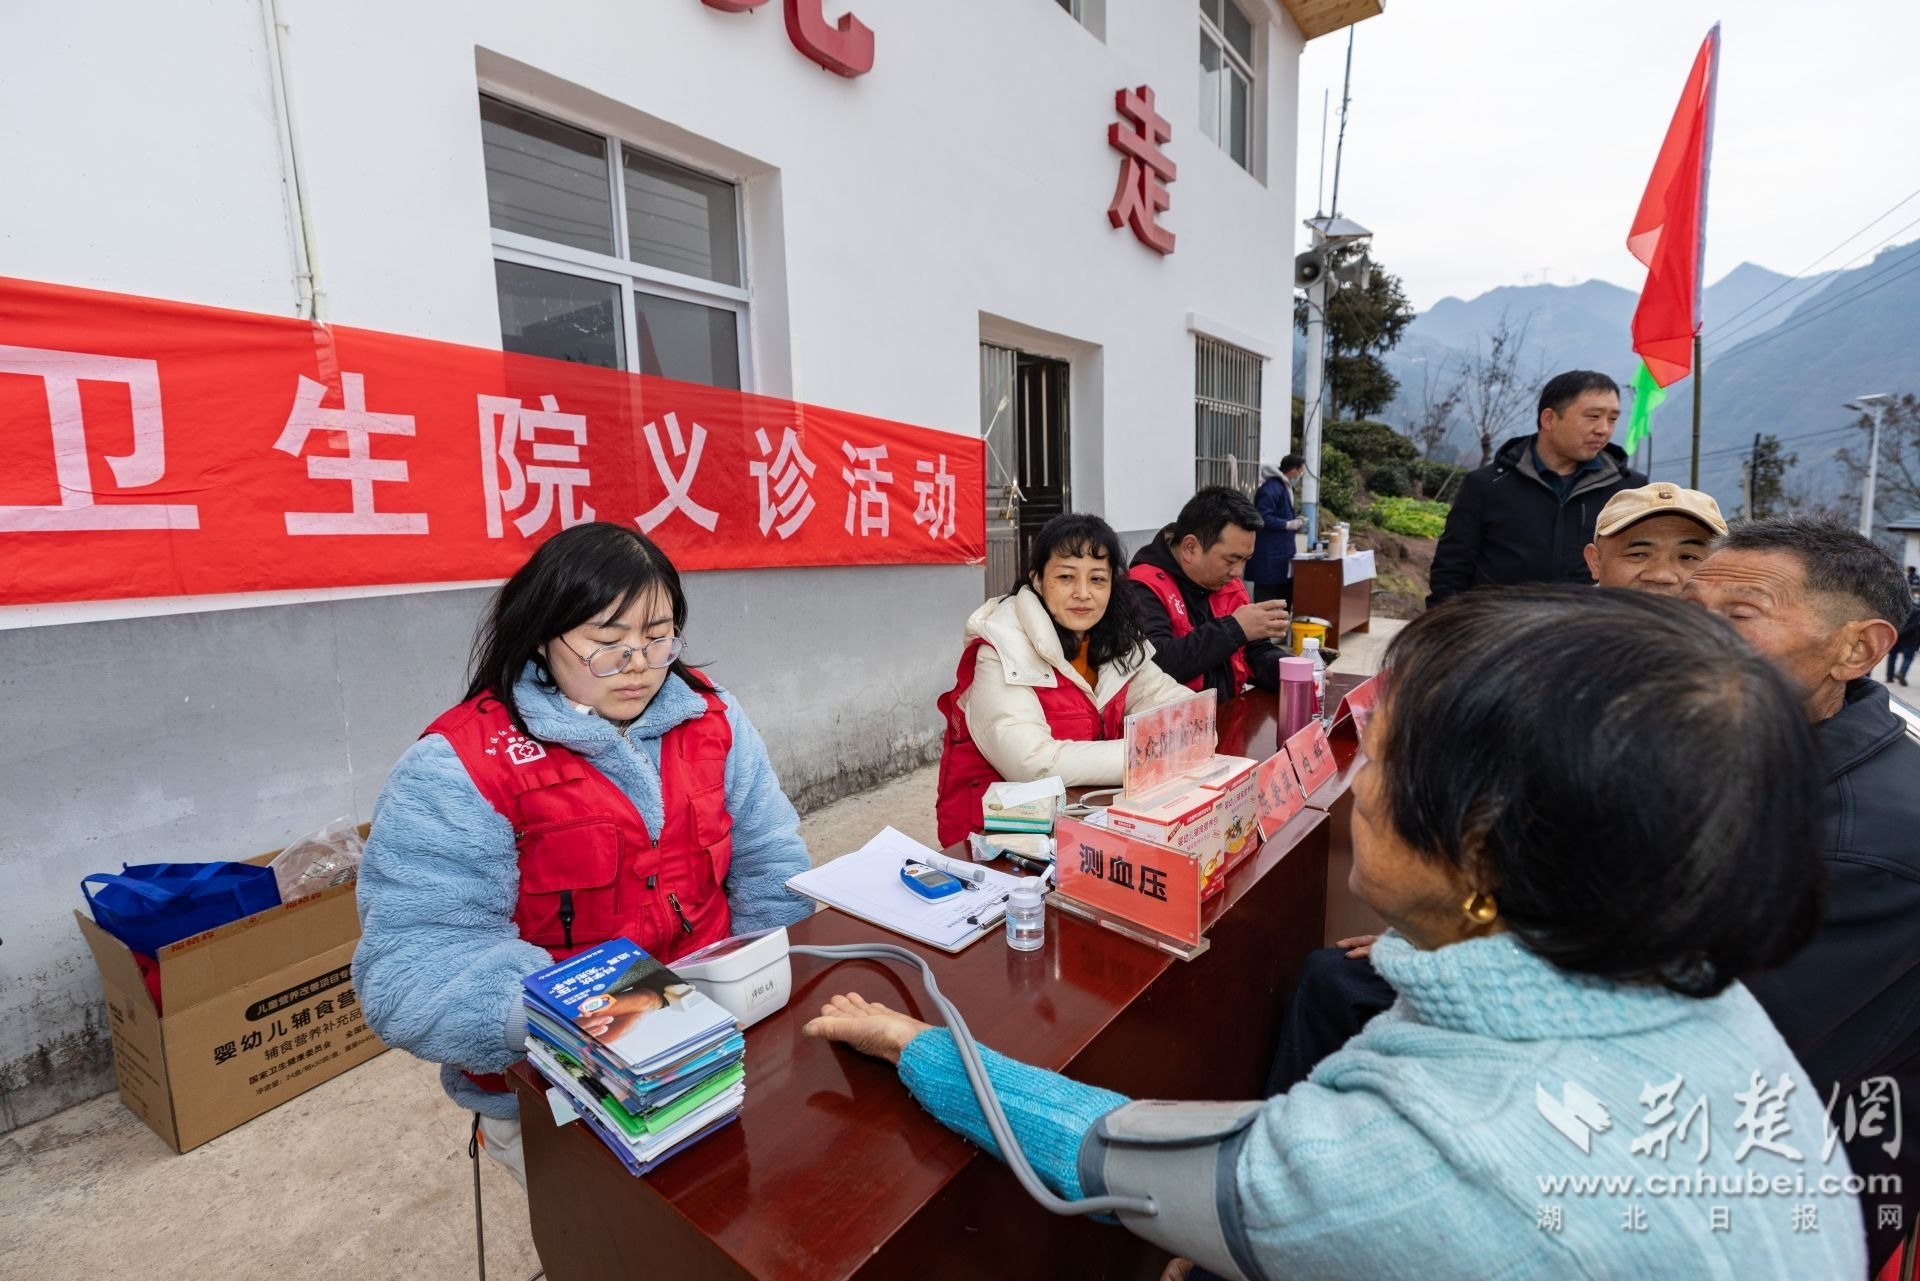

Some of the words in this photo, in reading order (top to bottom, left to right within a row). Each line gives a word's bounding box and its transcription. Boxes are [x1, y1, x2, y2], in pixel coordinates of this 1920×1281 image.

[1107, 84, 1177, 256] 走
[0, 344, 957, 541] 卫生院义诊活动
[1079, 843, 1168, 902] 测血压
[257, 968, 352, 1016] 儿童营养改善项目专
[264, 1007, 362, 1061] 辅食营养补充品
